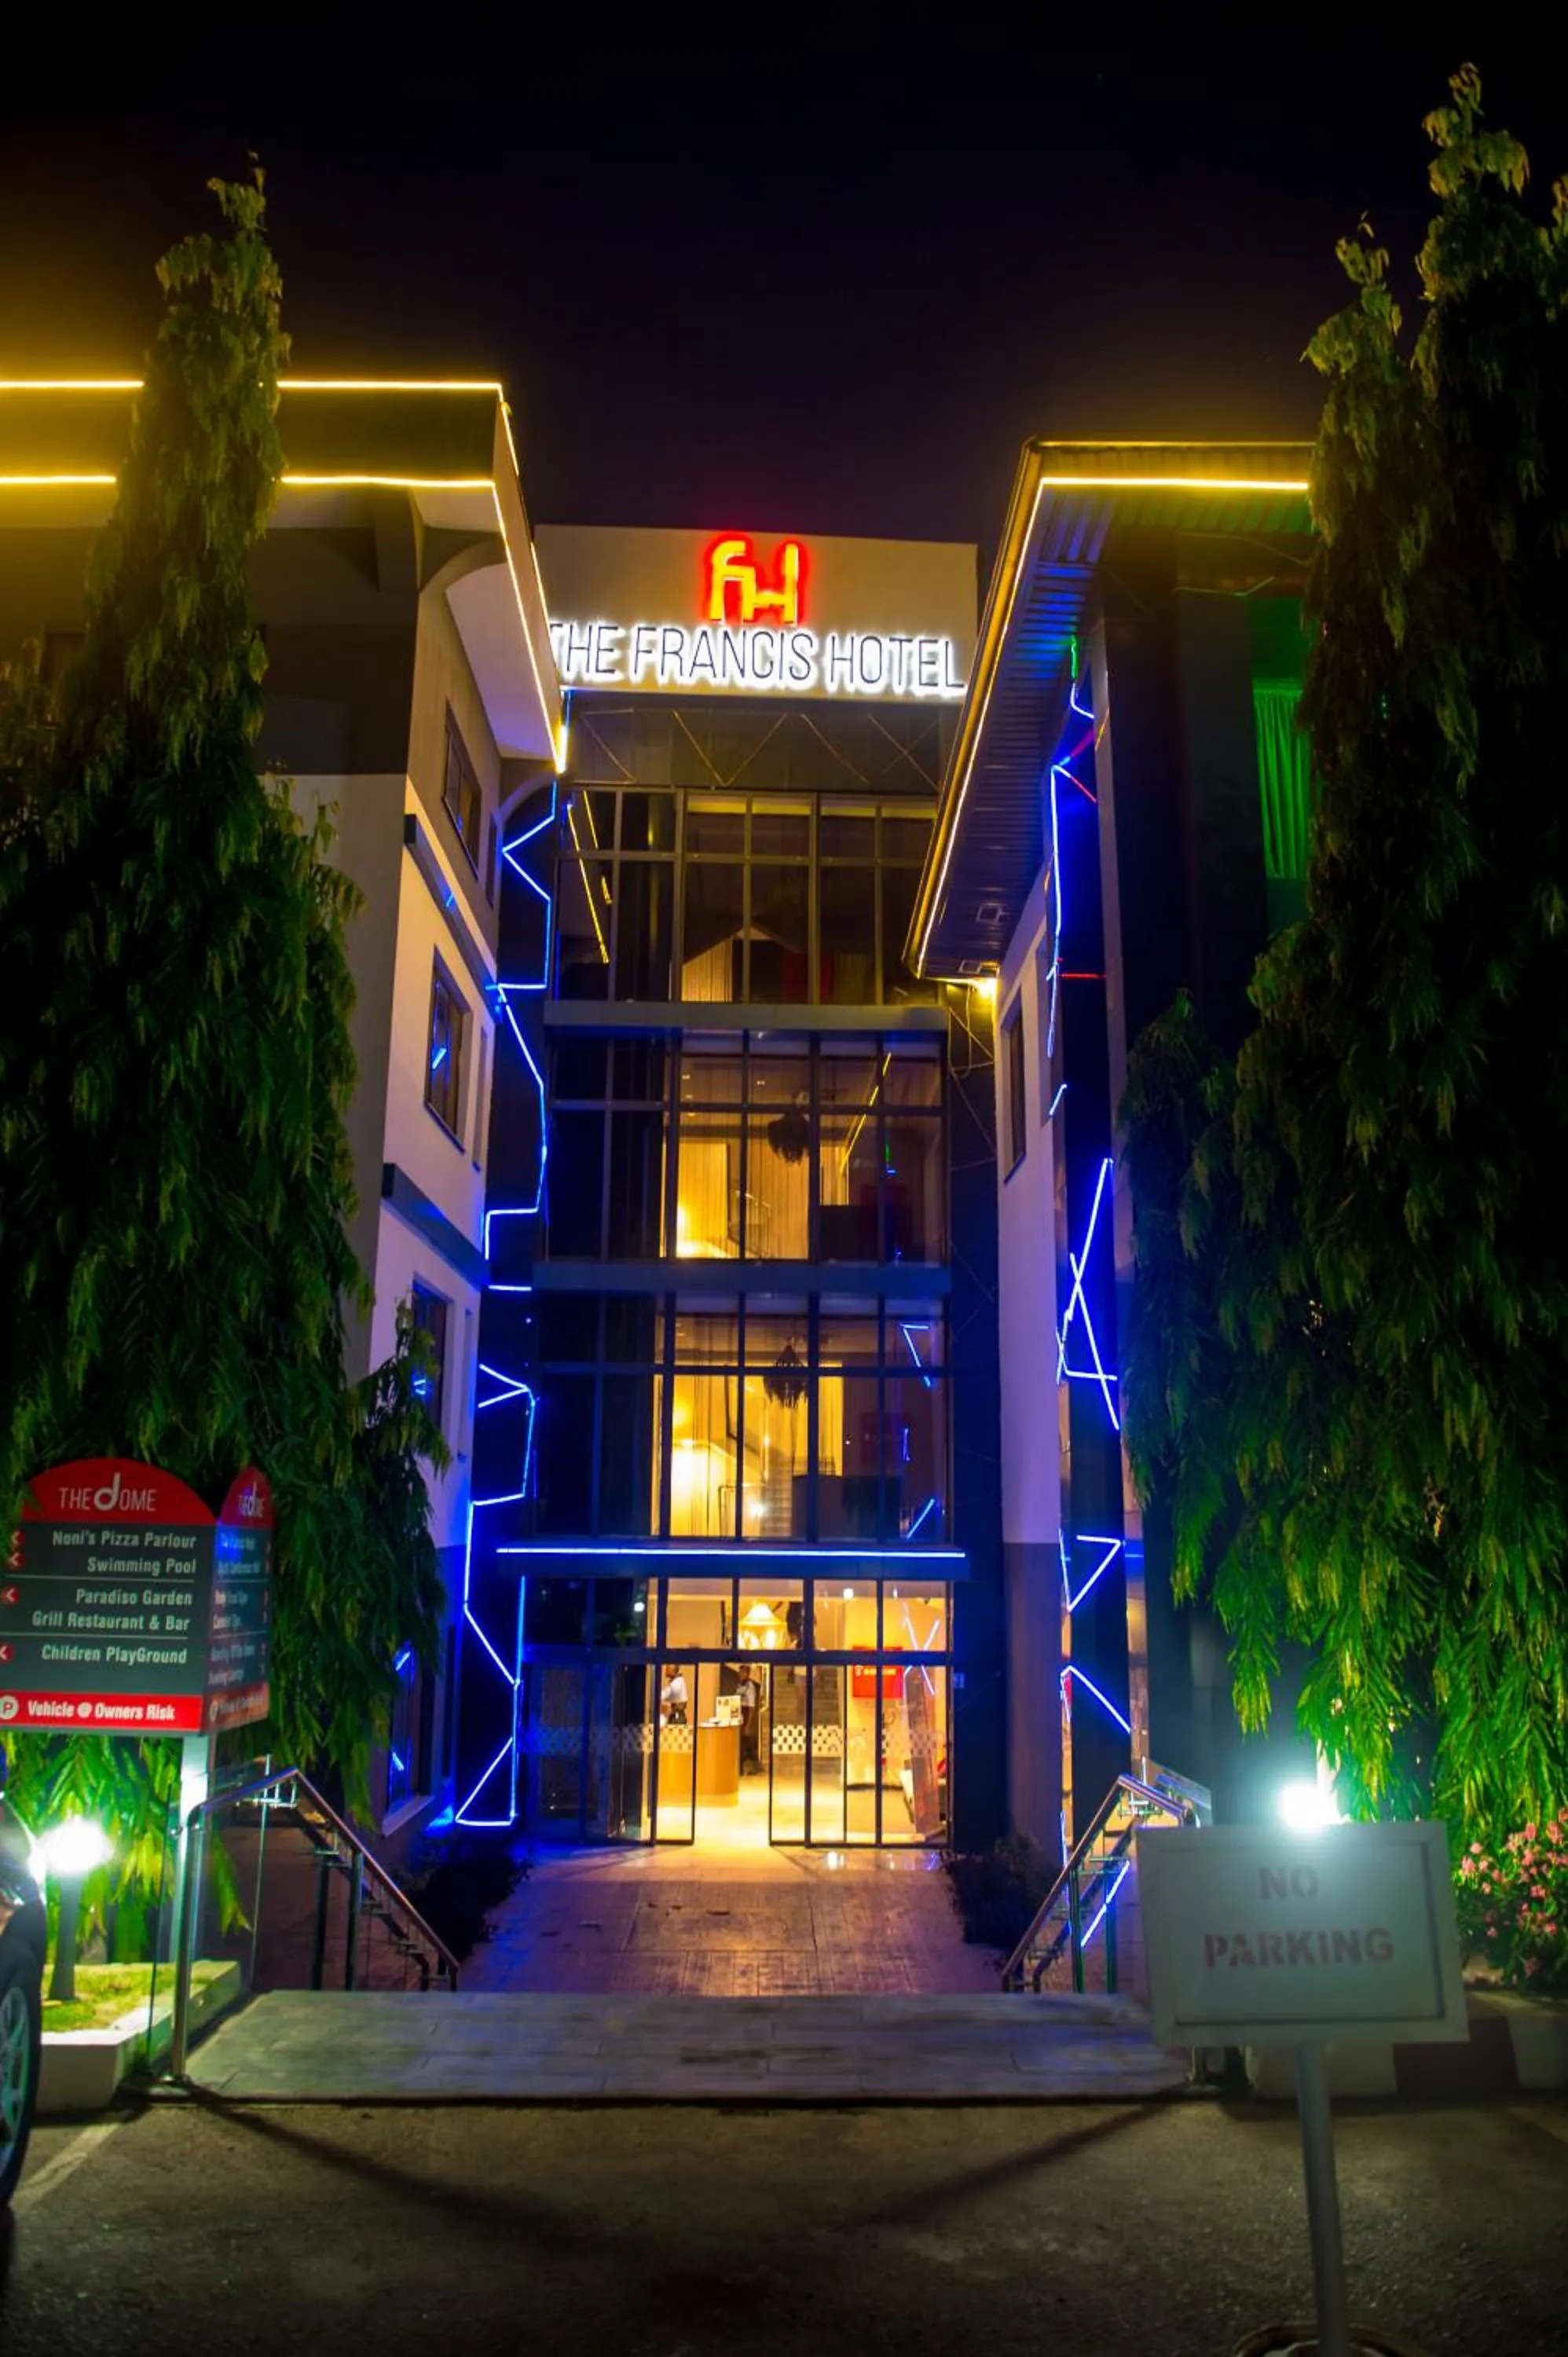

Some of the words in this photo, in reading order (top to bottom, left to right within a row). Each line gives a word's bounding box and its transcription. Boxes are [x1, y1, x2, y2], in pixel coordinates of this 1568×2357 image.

[633, 627, 814, 681] FRANCIS
[830, 635, 965, 688] HOTEL
[58, 1486, 93, 1510] THE
[52, 1530, 97, 1548] Noni's
[101, 1530, 140, 1548] Pizza
[144, 1532, 197, 1549] Parlour
[87, 1556, 161, 1577] Swimming
[166, 1558, 196, 1574] Pool
[76, 1588, 138, 1605] Paradiso
[142, 1589, 192, 1606] Garden
[32, 1611, 63, 1628] Grill
[67, 1612, 145, 1630] Restaurant
[148, 1615, 160, 1631] &
[165, 1615, 190, 1632] Bar
[42, 1644, 101, 1661] Children
[105, 1646, 188, 1666] PlayGround
[28, 1699, 75, 1718] Vehicle
[94, 1703, 143, 1721] Owners
[146, 1703, 176, 1721] Risk
[1259, 1866, 1320, 1899] NO
[1203, 1927, 1395, 1968] PARKING
